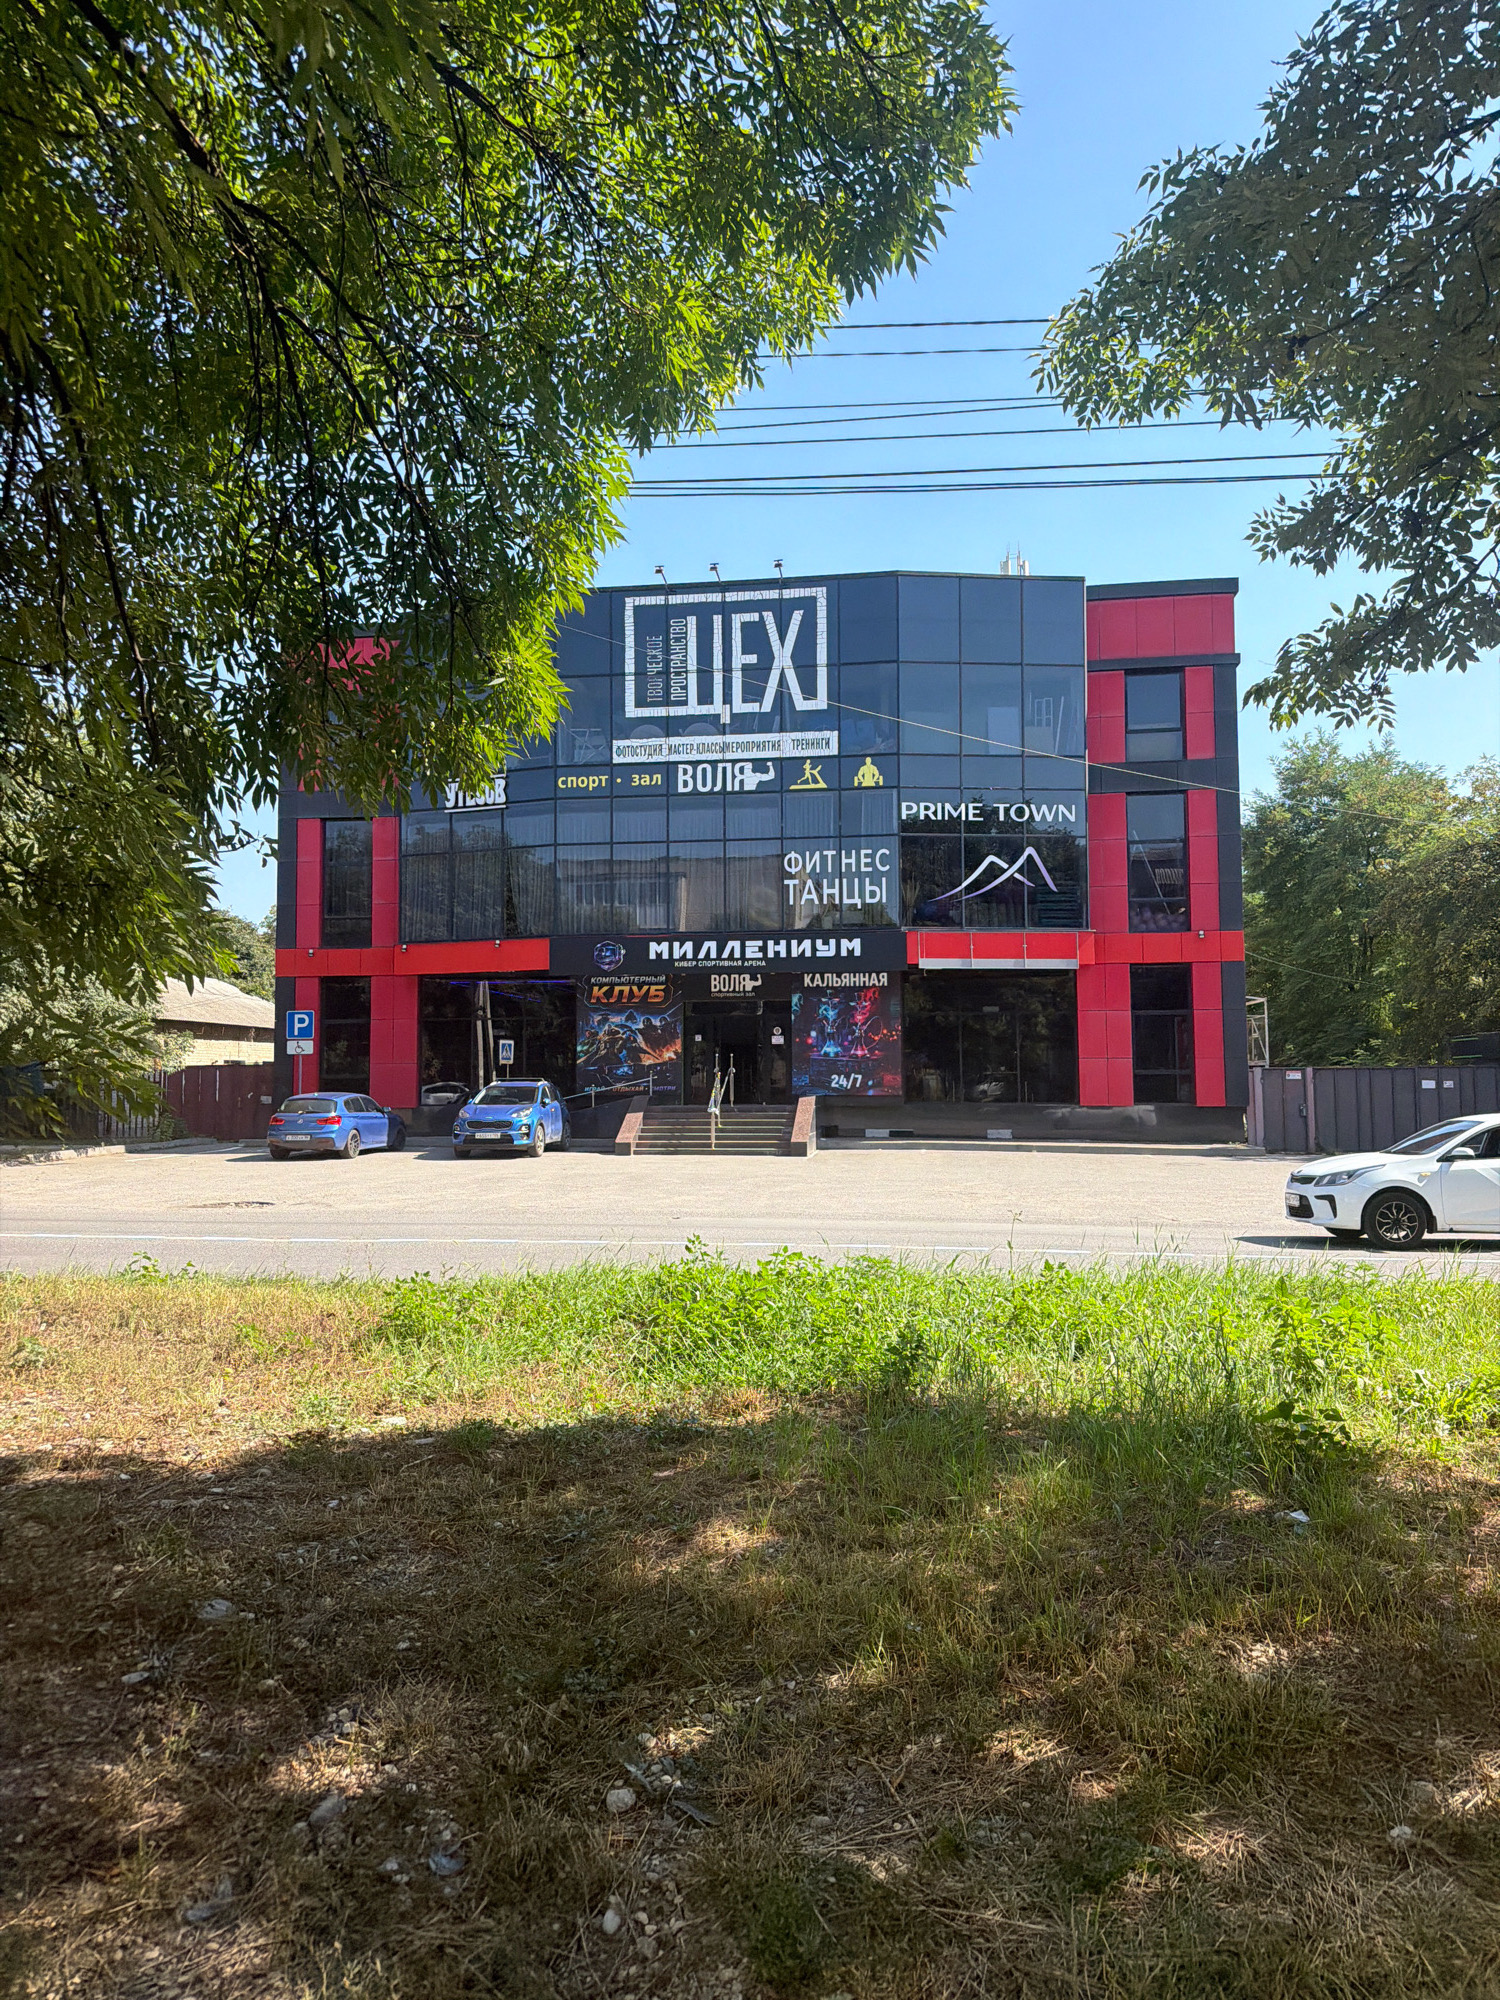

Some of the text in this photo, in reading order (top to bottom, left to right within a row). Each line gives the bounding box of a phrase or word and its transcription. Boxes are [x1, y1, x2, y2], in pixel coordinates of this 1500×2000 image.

[646, 635, 663, 703] ТВОРЧЕСКОЕ
[670, 618, 687, 701] ПРОСТРАНСТВО
[687, 609, 805, 724] ЦЕХ
[615, 743, 663, 759] ФОТОСТУДИЯ
[725, 738, 781, 754] МЕРОПРИЯТИЯ
[792, 736, 831, 752] ТРЕНИНГИ
[557, 772, 662, 792] спорт зал
[677, 762, 753, 793] ВОЛЯ
[901, 801, 1076, 823] PRIME TOWN
[784, 848, 891, 875] ФИТНЕС
[784, 877, 887, 909] ТАНЦЫ
[649, 938, 862, 960] МИЛЛЕНИУМ
[590, 974, 666, 985] КОМПЬЮТЕРНЫЙ
[711, 974, 751, 992] ВОЛЯ
[804, 972, 888, 988] КАЛЬЯННАЯ
[590, 985, 667, 1003] КЛУБ
[294, 1014, 309, 1036] P
[831, 1073, 862, 1089] 24/7
